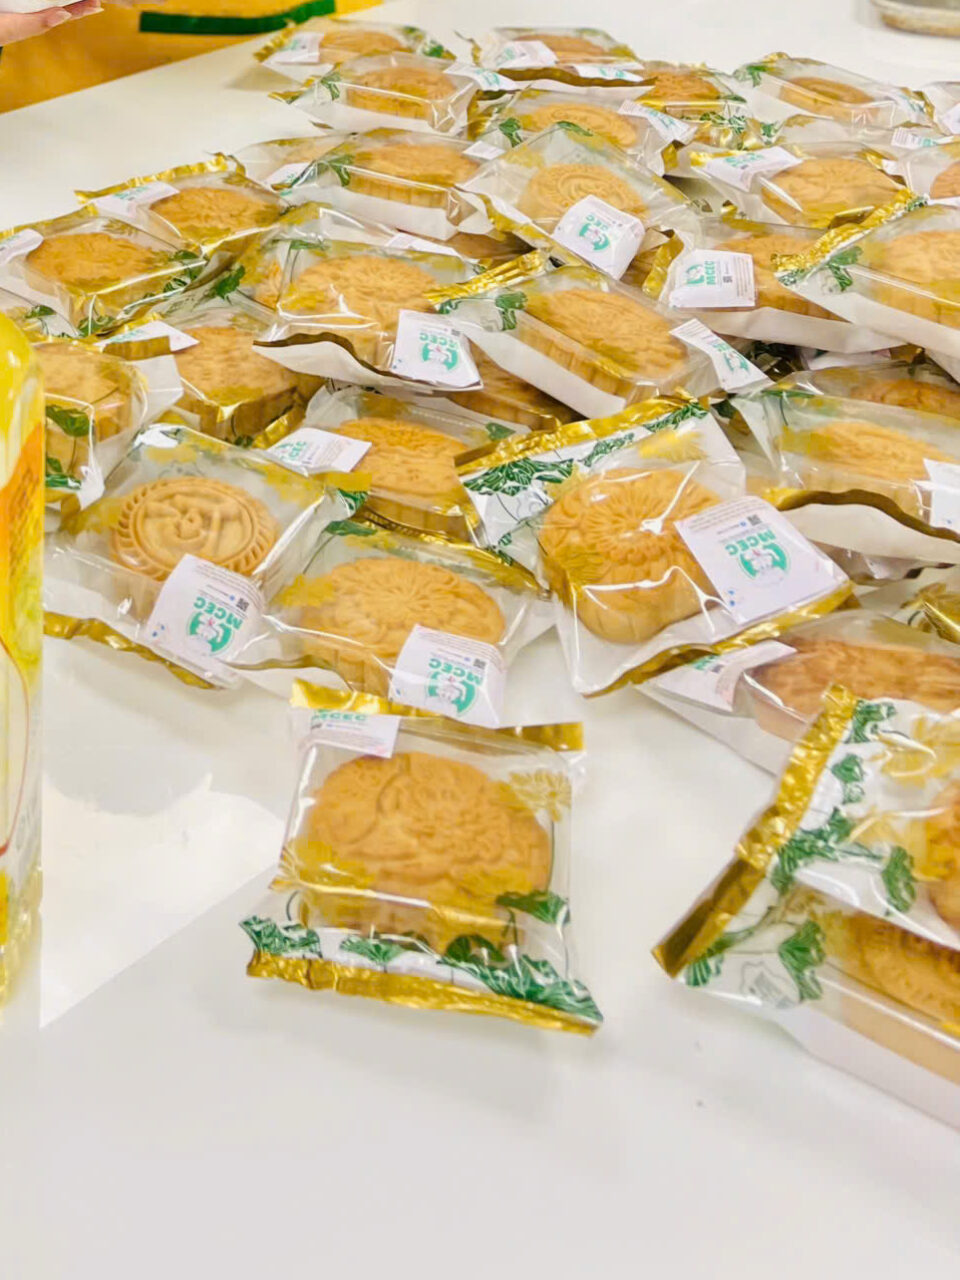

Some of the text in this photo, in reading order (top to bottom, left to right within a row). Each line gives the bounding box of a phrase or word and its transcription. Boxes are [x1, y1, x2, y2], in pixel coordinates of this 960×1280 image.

[724, 529, 777, 556] MCEC
[193, 596, 243, 631] MCEC
[428, 657, 484, 687] MCEC
